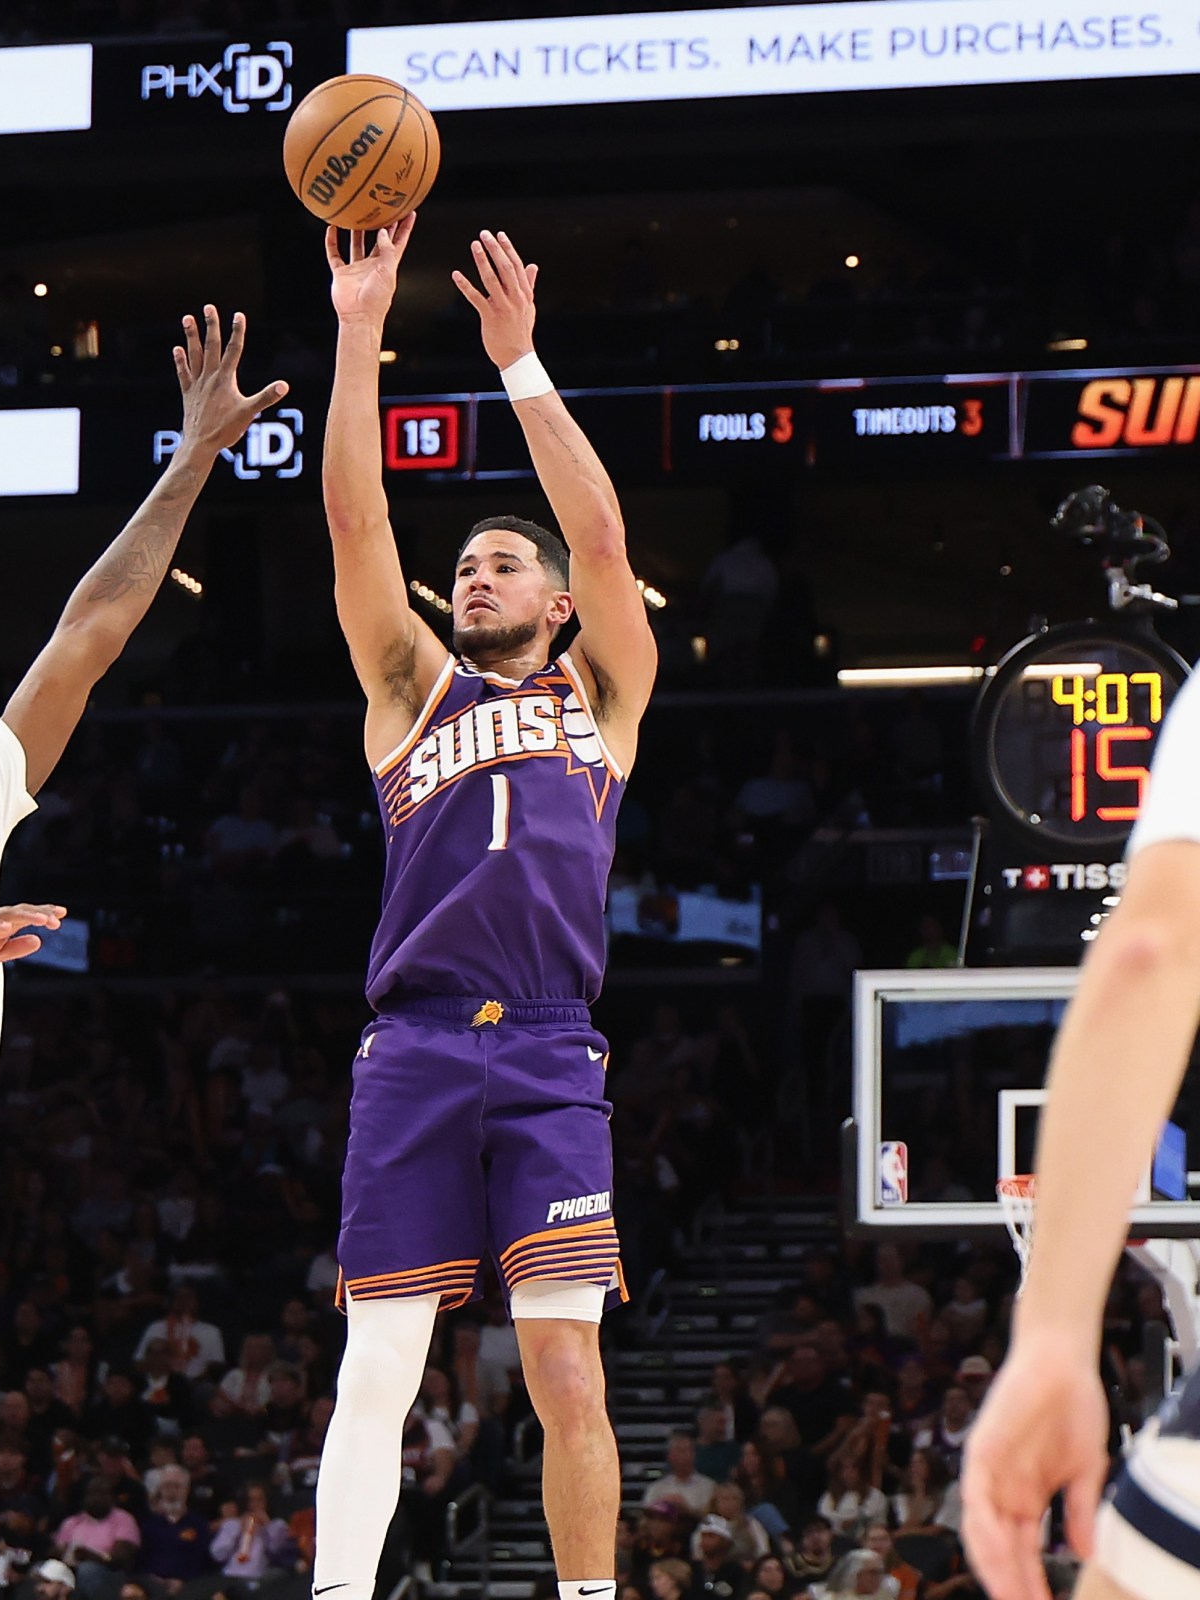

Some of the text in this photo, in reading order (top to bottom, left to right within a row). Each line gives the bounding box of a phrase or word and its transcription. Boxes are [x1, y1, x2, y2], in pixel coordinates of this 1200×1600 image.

[405, 47, 522, 84] SCAN
[535, 36, 720, 77] TICKETS.
[746, 28, 874, 66] MAKE
[889, 13, 1175, 59] PURCHASES.
[141, 61, 223, 100] PHX
[306, 122, 384, 206] Wilson
[403, 418, 441, 457] 15
[700, 406, 794, 444] FOULS 3
[853, 399, 984, 438] TIMEOUTS 3
[1051, 672, 1163, 726] 4:07
[1070, 726, 1153, 822] 15
[488, 773, 511, 851] 1
